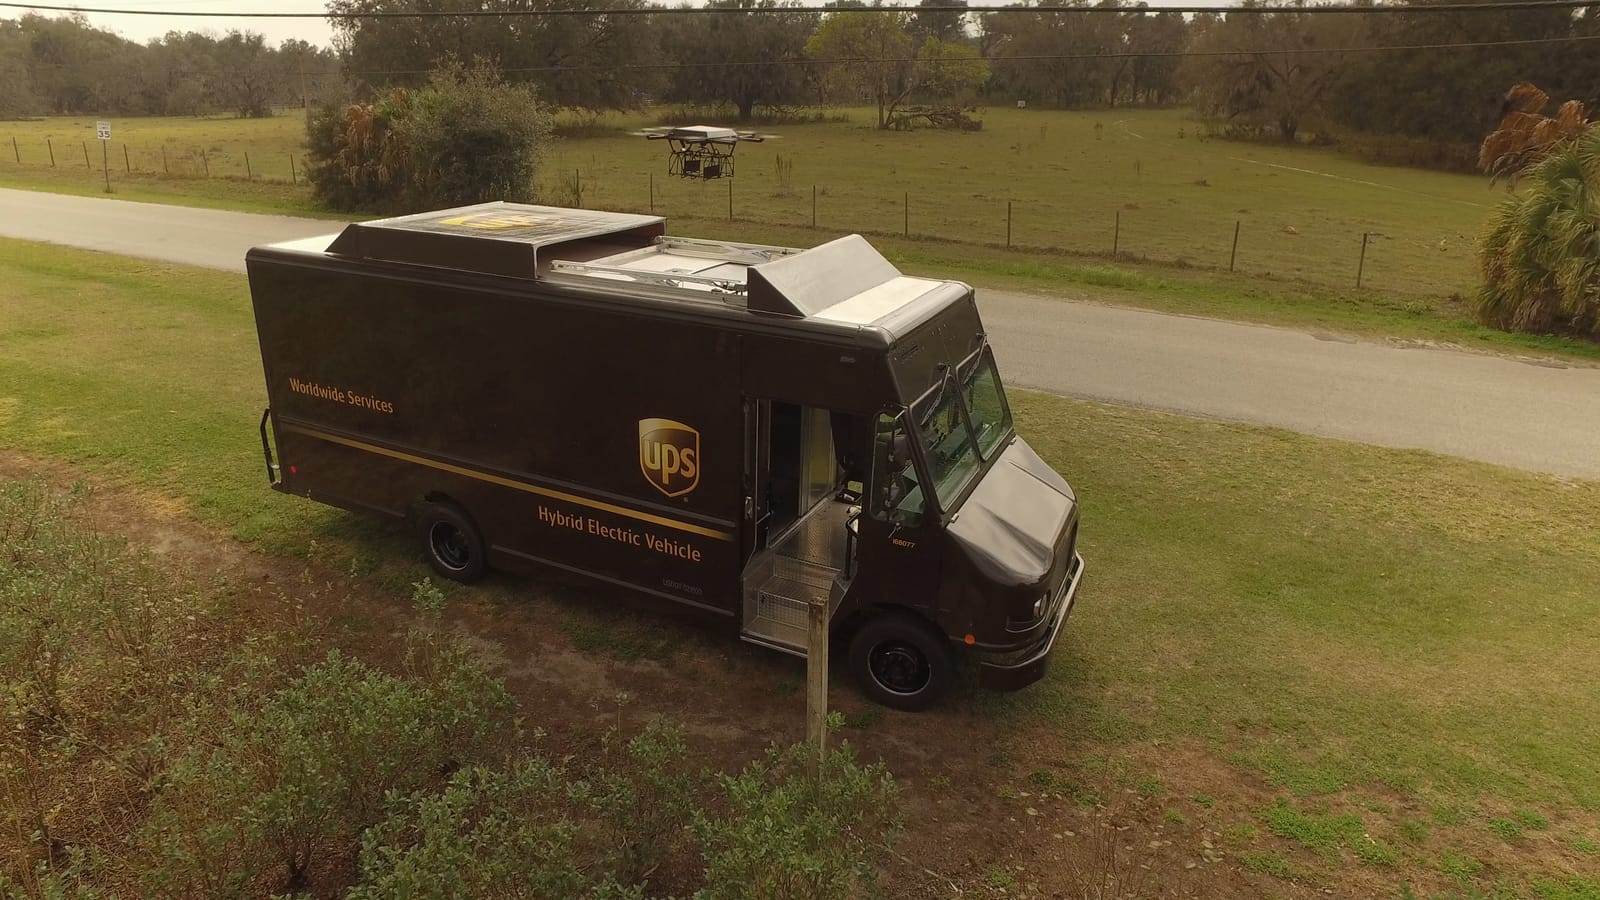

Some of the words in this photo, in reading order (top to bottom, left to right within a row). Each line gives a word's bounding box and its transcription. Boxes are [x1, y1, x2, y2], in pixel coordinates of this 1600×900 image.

[98, 130, 110, 138] 35
[289, 378, 345, 402] Worldwide
[347, 391, 394, 413] Services
[538, 505, 583, 530] Hybrid
[588, 518, 640, 546] Electric
[645, 533, 701, 561] Vehicle
